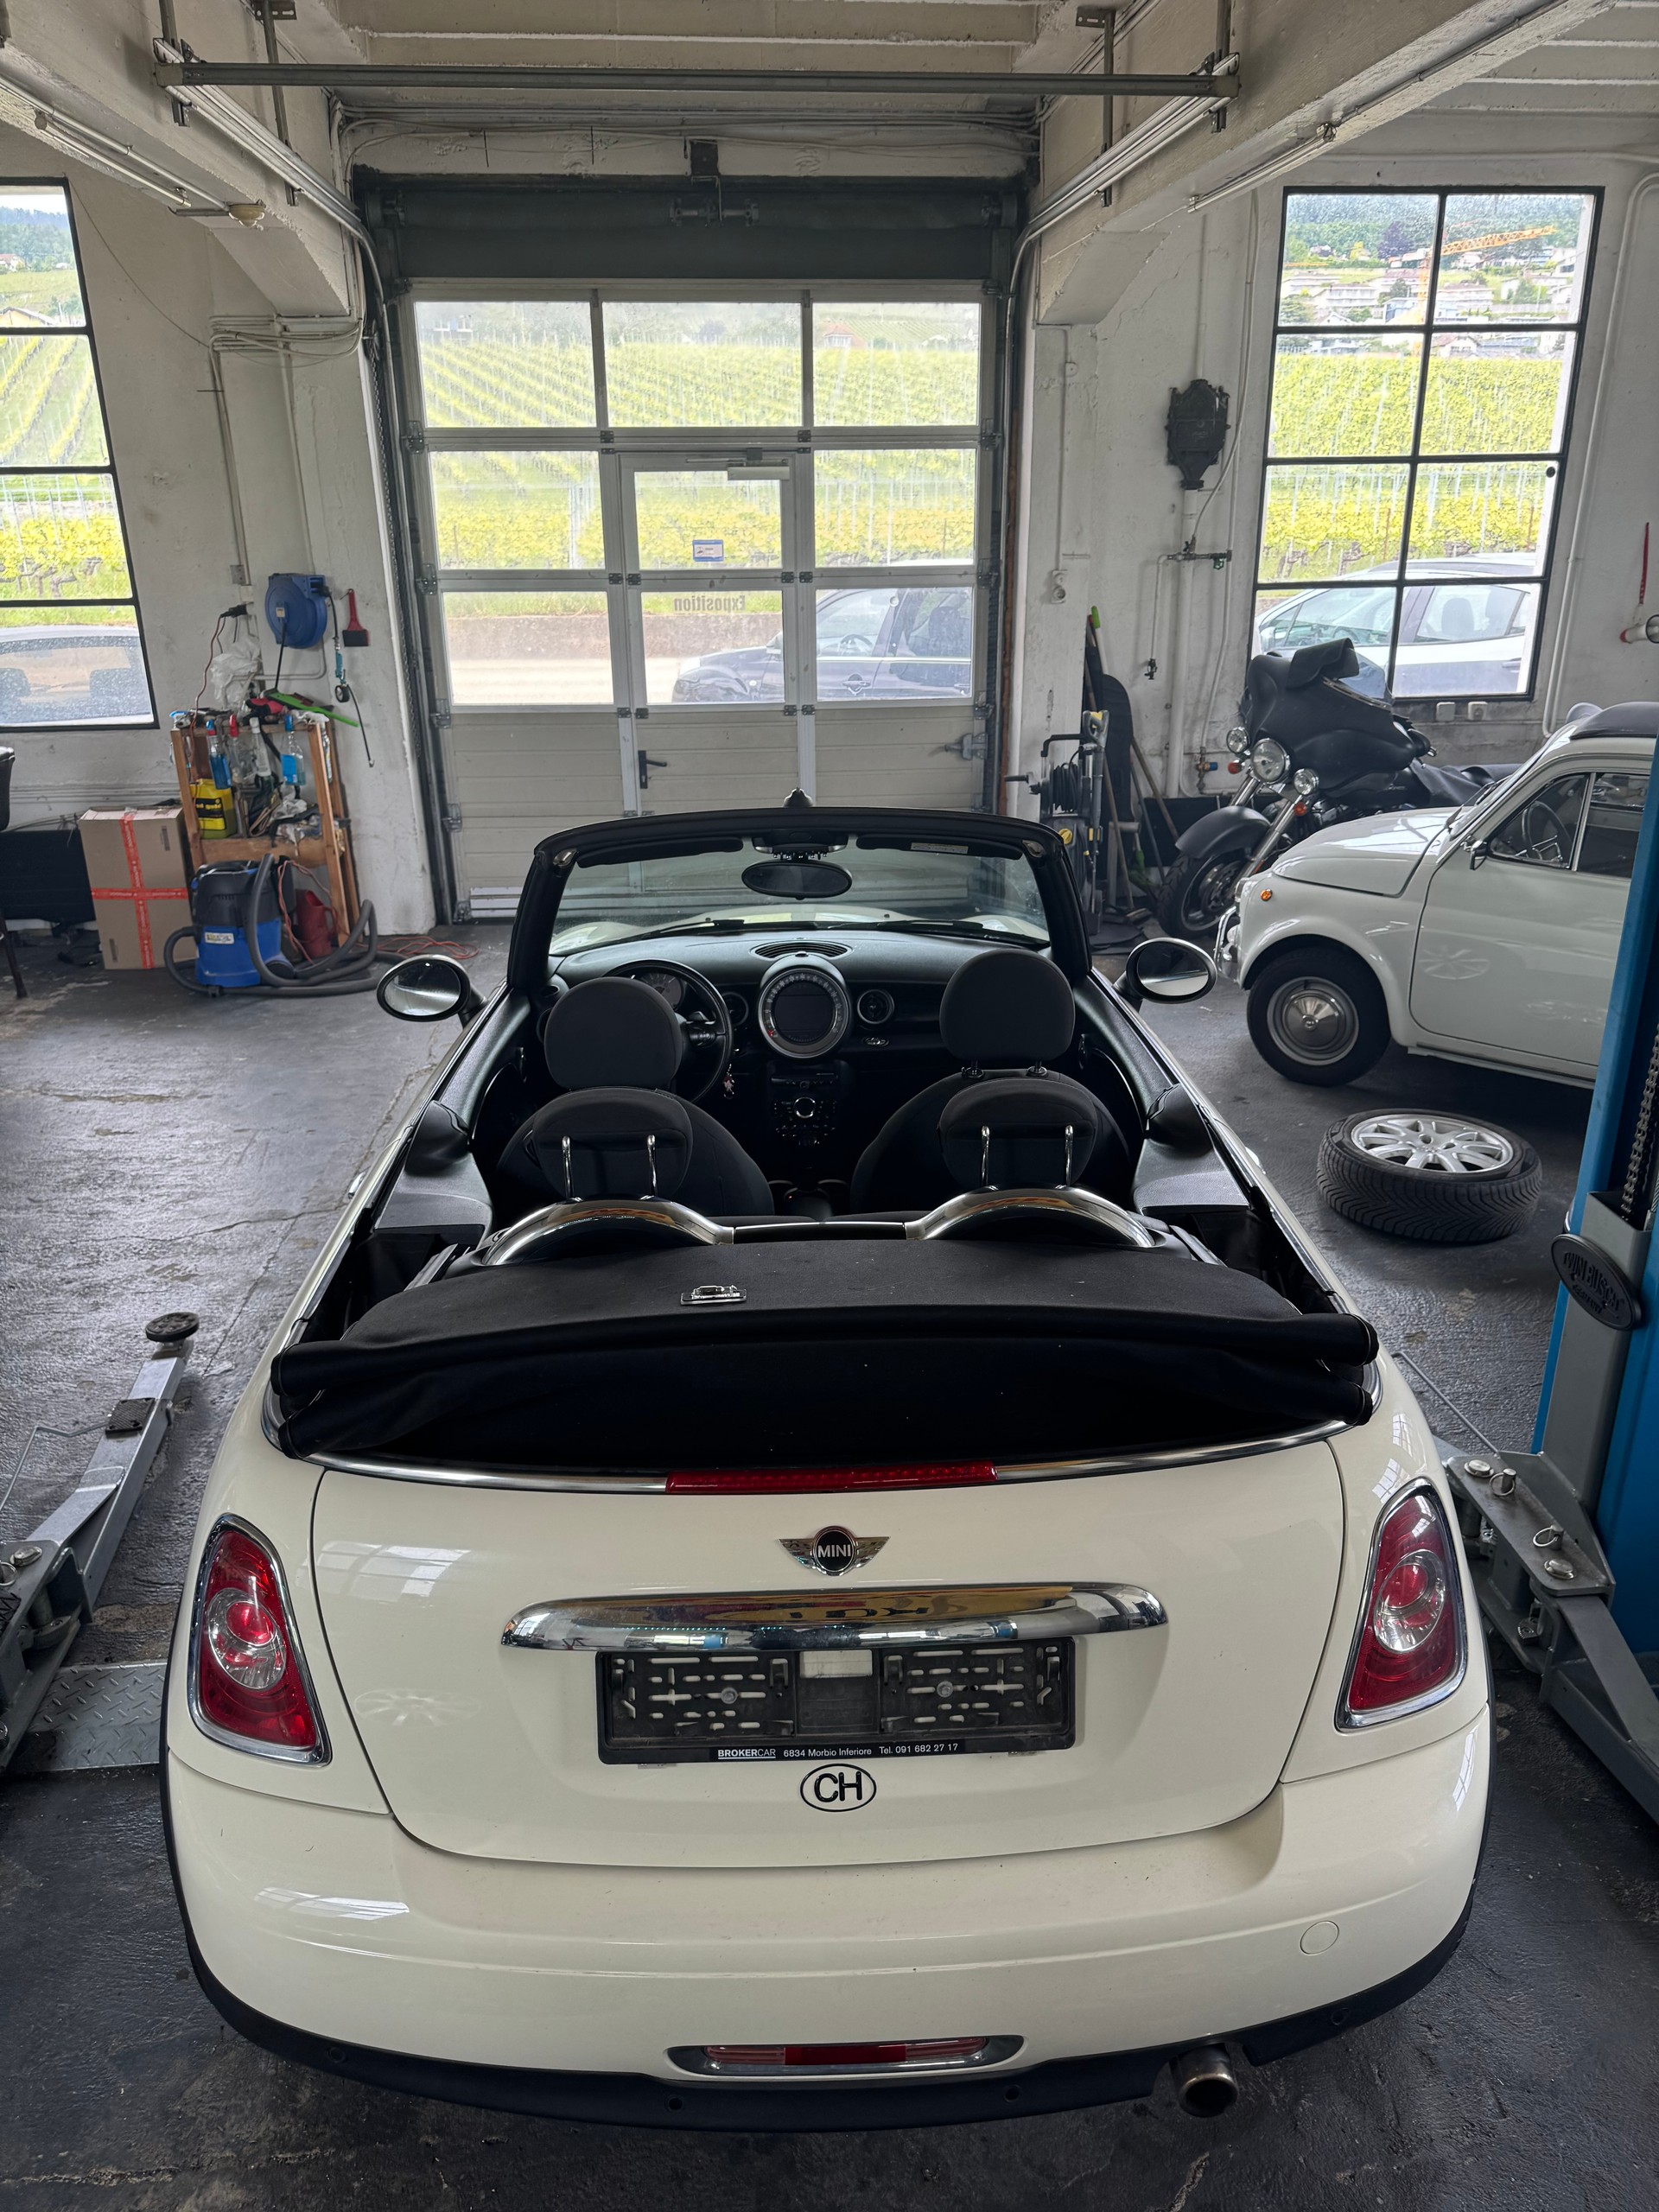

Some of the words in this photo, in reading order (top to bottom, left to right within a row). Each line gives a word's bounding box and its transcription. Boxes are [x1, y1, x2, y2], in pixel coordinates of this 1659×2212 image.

[817, 1544, 851, 1558] MINI
[717, 1748, 776, 1758] BROKERCAR
[783, 1749, 805, 1758] 6834
[808, 1748, 837, 1757] Morbio
[838, 1747, 872, 1757] Inferiore
[879, 1745, 893, 1754] Tel.
[895, 1745, 912, 1754] 091
[914, 1744, 931, 1753] 682
[933, 1744, 944, 1752] 27
[948, 1743, 958, 1751] 17
[814, 1770, 863, 1802] CH
